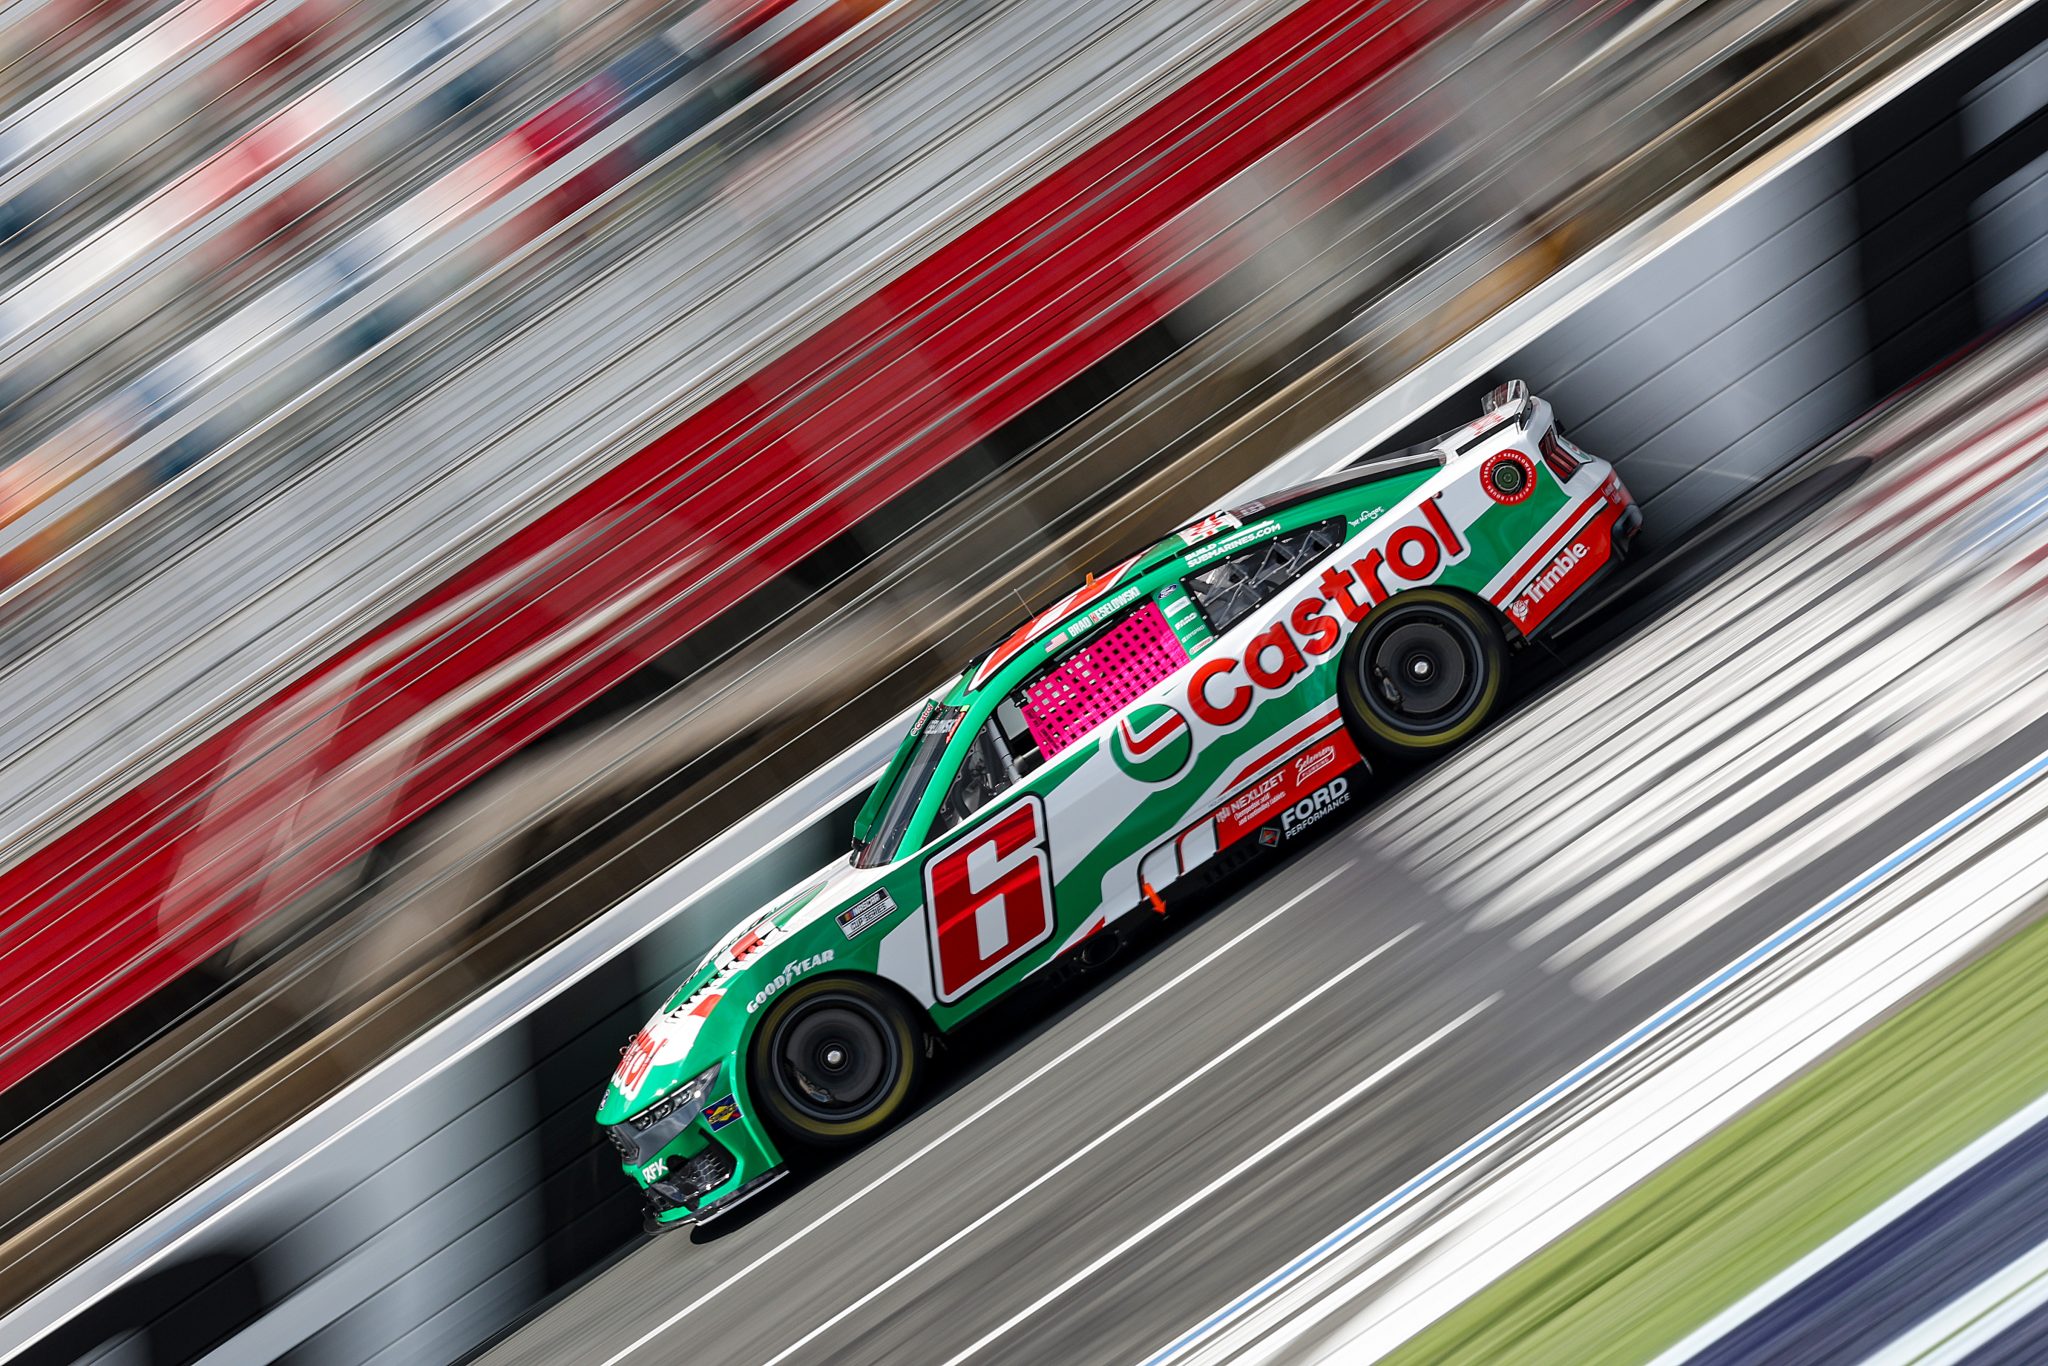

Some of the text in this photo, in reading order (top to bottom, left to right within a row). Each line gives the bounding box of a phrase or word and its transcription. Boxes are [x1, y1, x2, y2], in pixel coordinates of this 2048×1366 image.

[1184, 543, 1217, 562] BUILD
[1187, 523, 1281, 568] SUBMARINES.COM
[1522, 543, 1588, 604] Trimble
[1068, 616, 1092, 638] BRAD
[1089, 586, 1142, 624] KESELOWSKI
[1187, 498, 1464, 726] Castrol
[915, 703, 934, 729] Castrol
[1230, 771, 1284, 814] NEXLIZET
[1281, 777, 1348, 831] FORD
[1285, 792, 1351, 840] PERFORMANCE
[925, 796, 1053, 1003] 6
[746, 949, 835, 1014] GOODYEAR
[642, 1158, 669, 1184] RFK
